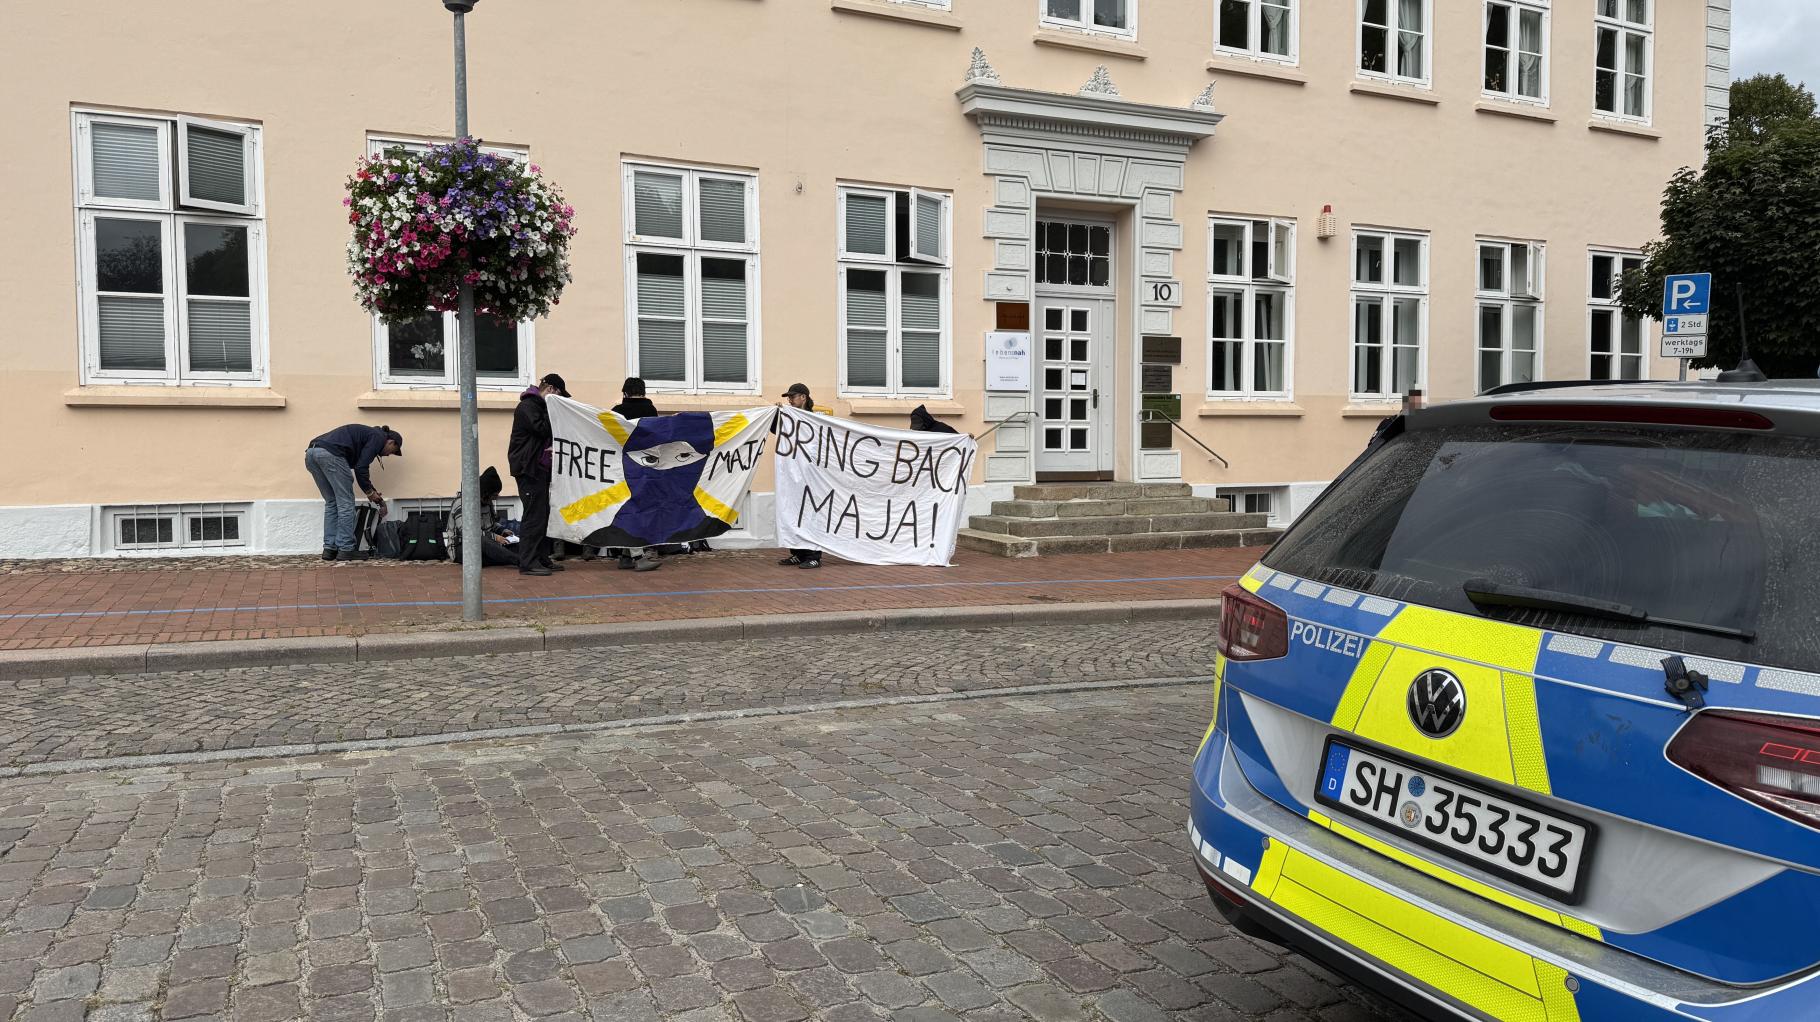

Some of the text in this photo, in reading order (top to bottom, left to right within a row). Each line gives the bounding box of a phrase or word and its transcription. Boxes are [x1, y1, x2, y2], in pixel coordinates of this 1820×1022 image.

[1153, 283, 1172, 301] 10
[1671, 280, 1696, 310] P
[1681, 320, 1704, 329] 2 Std.
[554, 437, 616, 484] FREE
[775, 410, 975, 496] BRING BACK
[797, 484, 939, 549] MAJA!
[1290, 621, 1364, 658] POLIZEI
[1328, 778, 1337, 790] D
[1350, 760, 1573, 879] SH 35333
